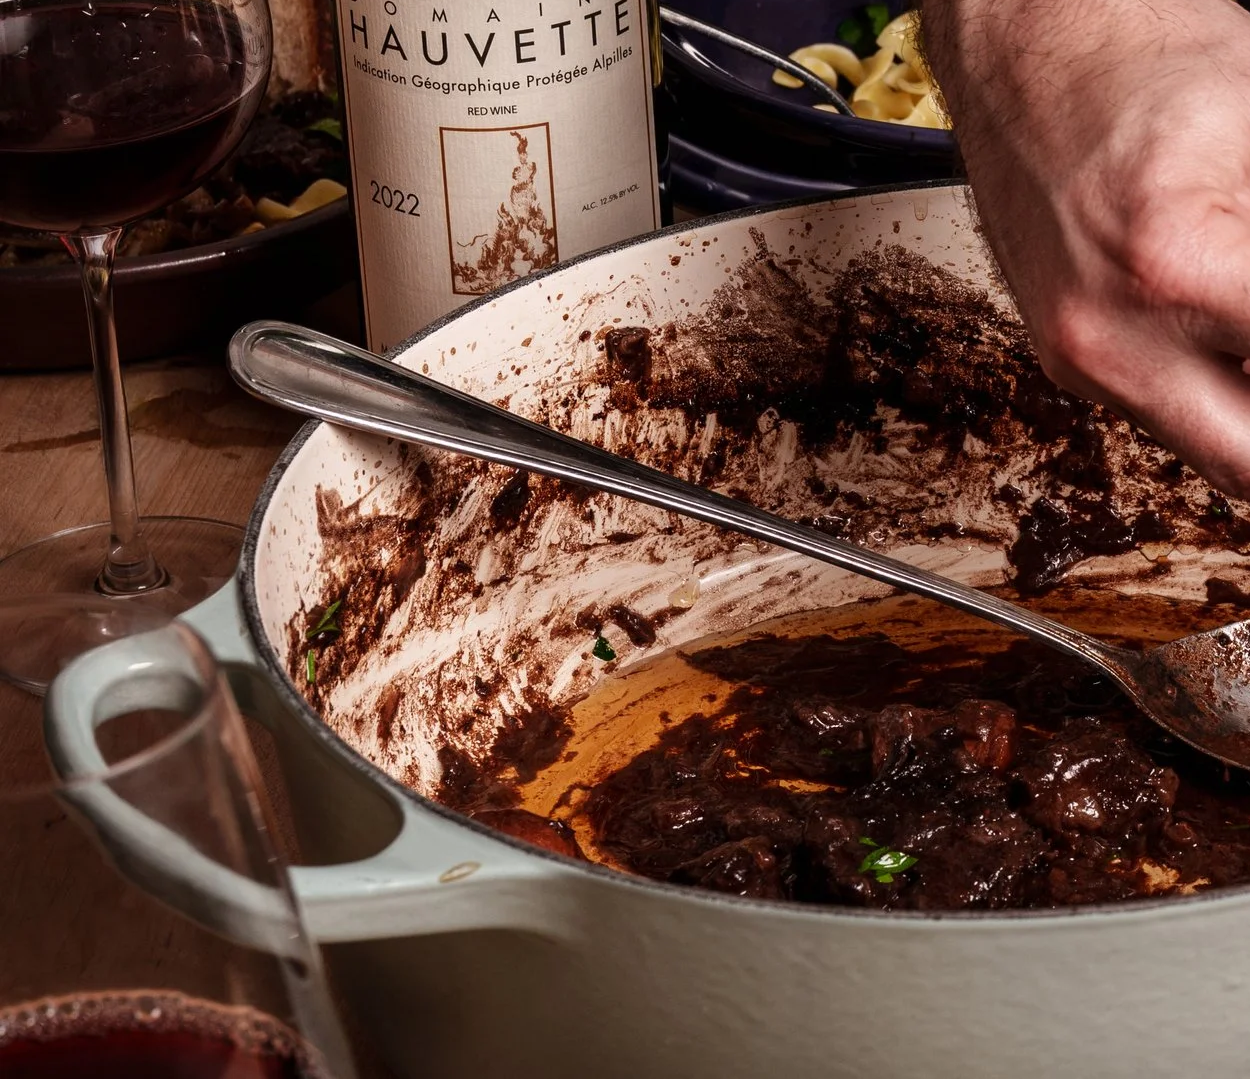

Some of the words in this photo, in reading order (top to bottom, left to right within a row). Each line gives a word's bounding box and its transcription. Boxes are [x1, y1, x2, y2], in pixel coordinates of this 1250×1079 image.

[354, 54, 407, 86] Indication
[411, 74, 521, 96] Géographique
[526, 65, 588, 88] Protégée
[592, 45, 634, 72] Alpilles
[467, 106, 489, 116] RED
[490, 104, 518, 116] WINE
[370, 180, 421, 218] 2022
